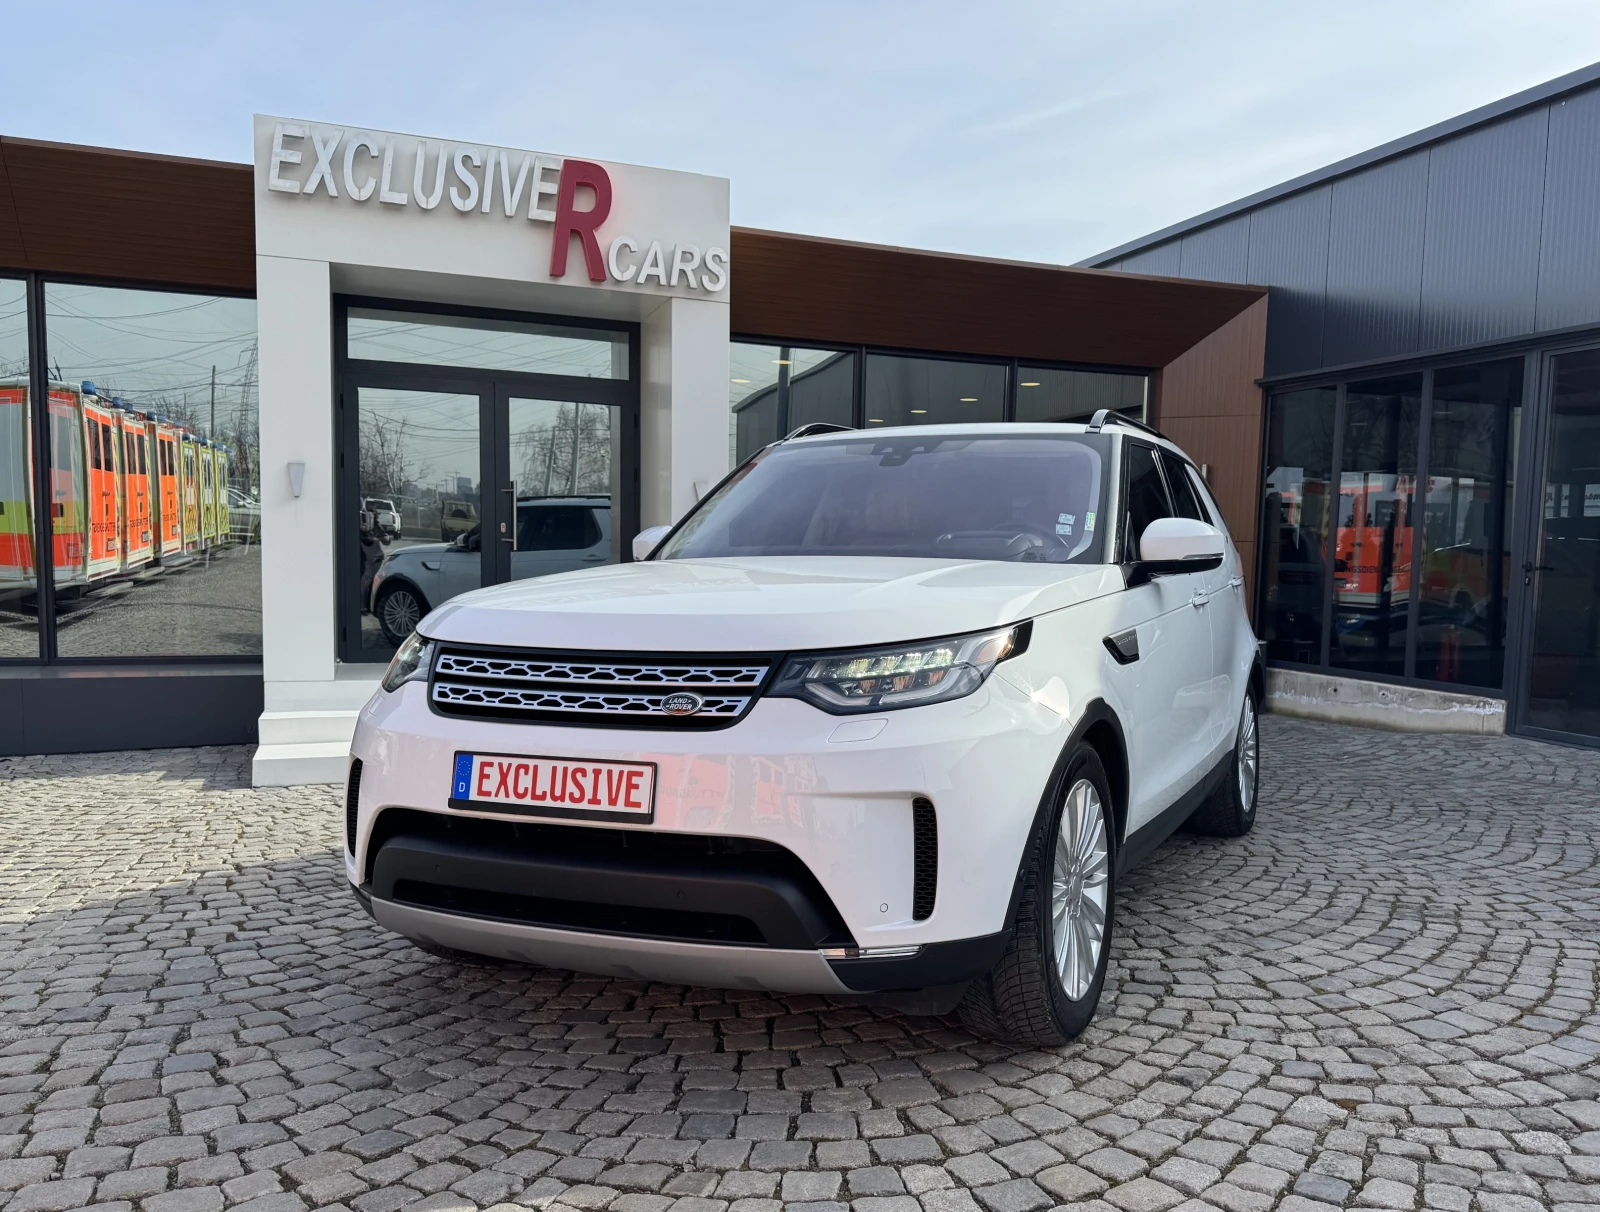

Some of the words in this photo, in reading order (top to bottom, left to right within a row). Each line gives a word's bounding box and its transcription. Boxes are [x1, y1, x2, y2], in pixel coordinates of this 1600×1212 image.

[268, 121, 562, 223] EXCLUSIVE
[607, 235, 728, 294] CARS
[458, 781, 466, 793] D
[476, 760, 645, 809] EXCLUSIVE
